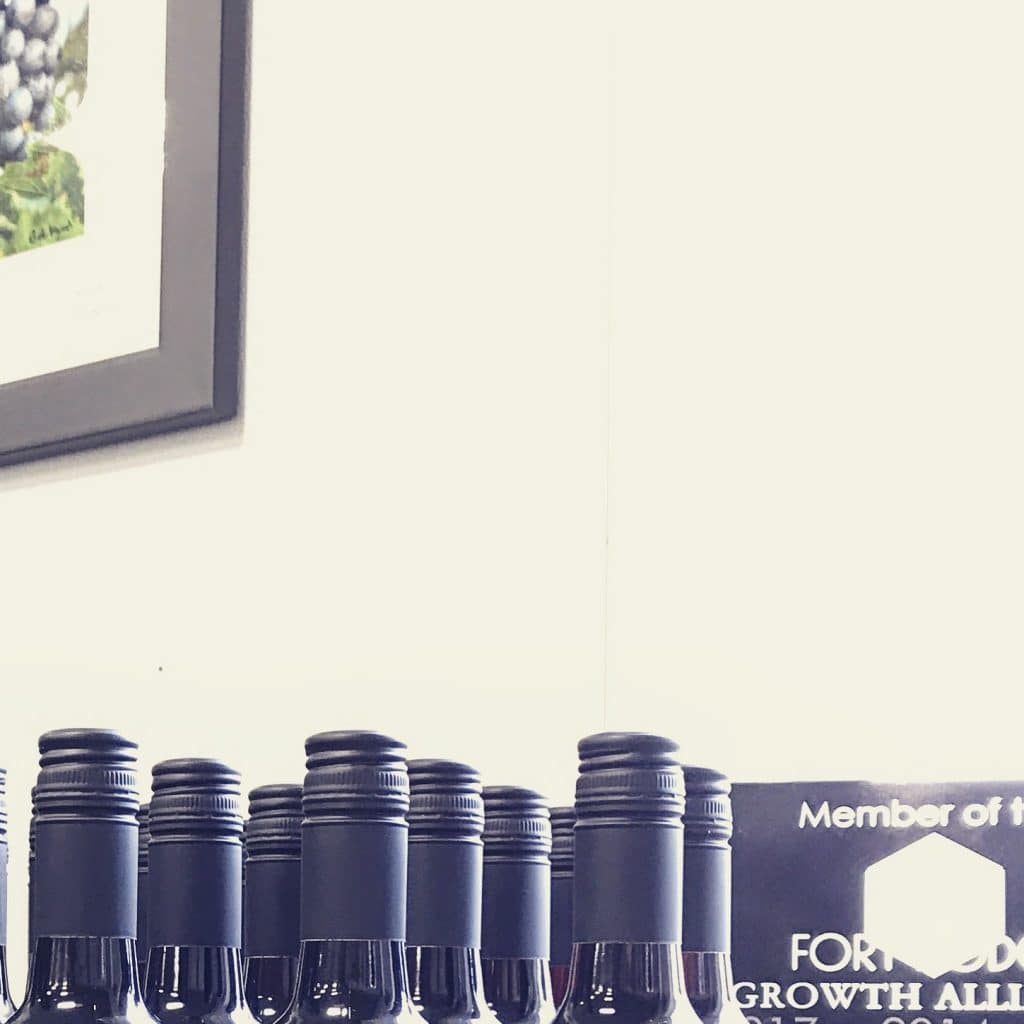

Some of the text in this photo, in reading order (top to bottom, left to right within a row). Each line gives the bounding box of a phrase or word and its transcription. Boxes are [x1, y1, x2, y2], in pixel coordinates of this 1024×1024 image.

[799, 798, 956, 829] Member
[962, 796, 1003, 827] of
[733, 982, 924, 1011] GROWTH
